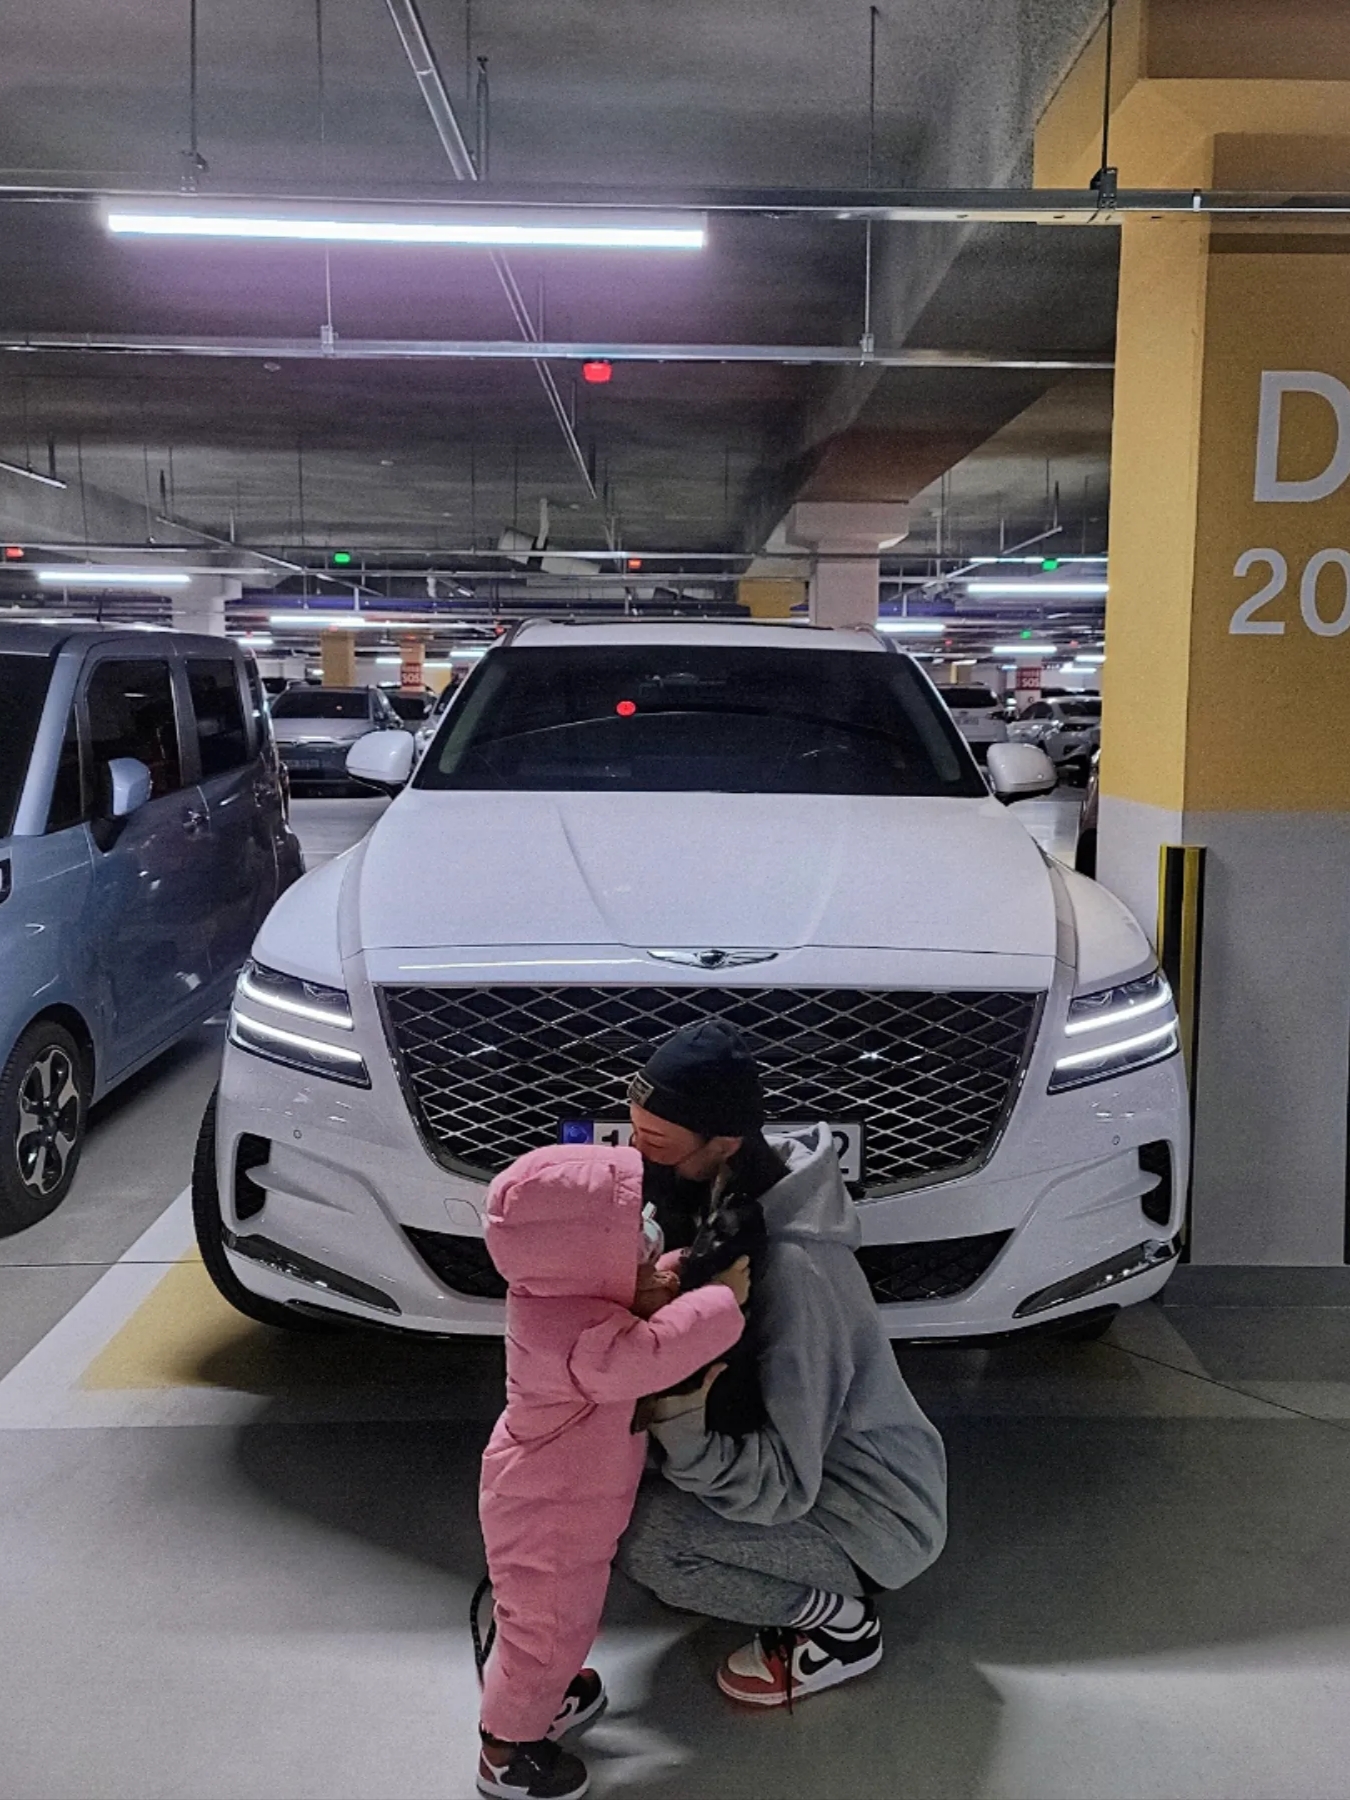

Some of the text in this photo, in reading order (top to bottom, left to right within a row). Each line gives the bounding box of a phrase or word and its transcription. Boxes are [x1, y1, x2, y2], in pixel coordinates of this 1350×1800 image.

[1254, 370, 1350, 502] D
[1229, 548, 1350, 636] 20
[402, 672, 421, 683] SOS
[1021, 677, 1040, 688] SOS
